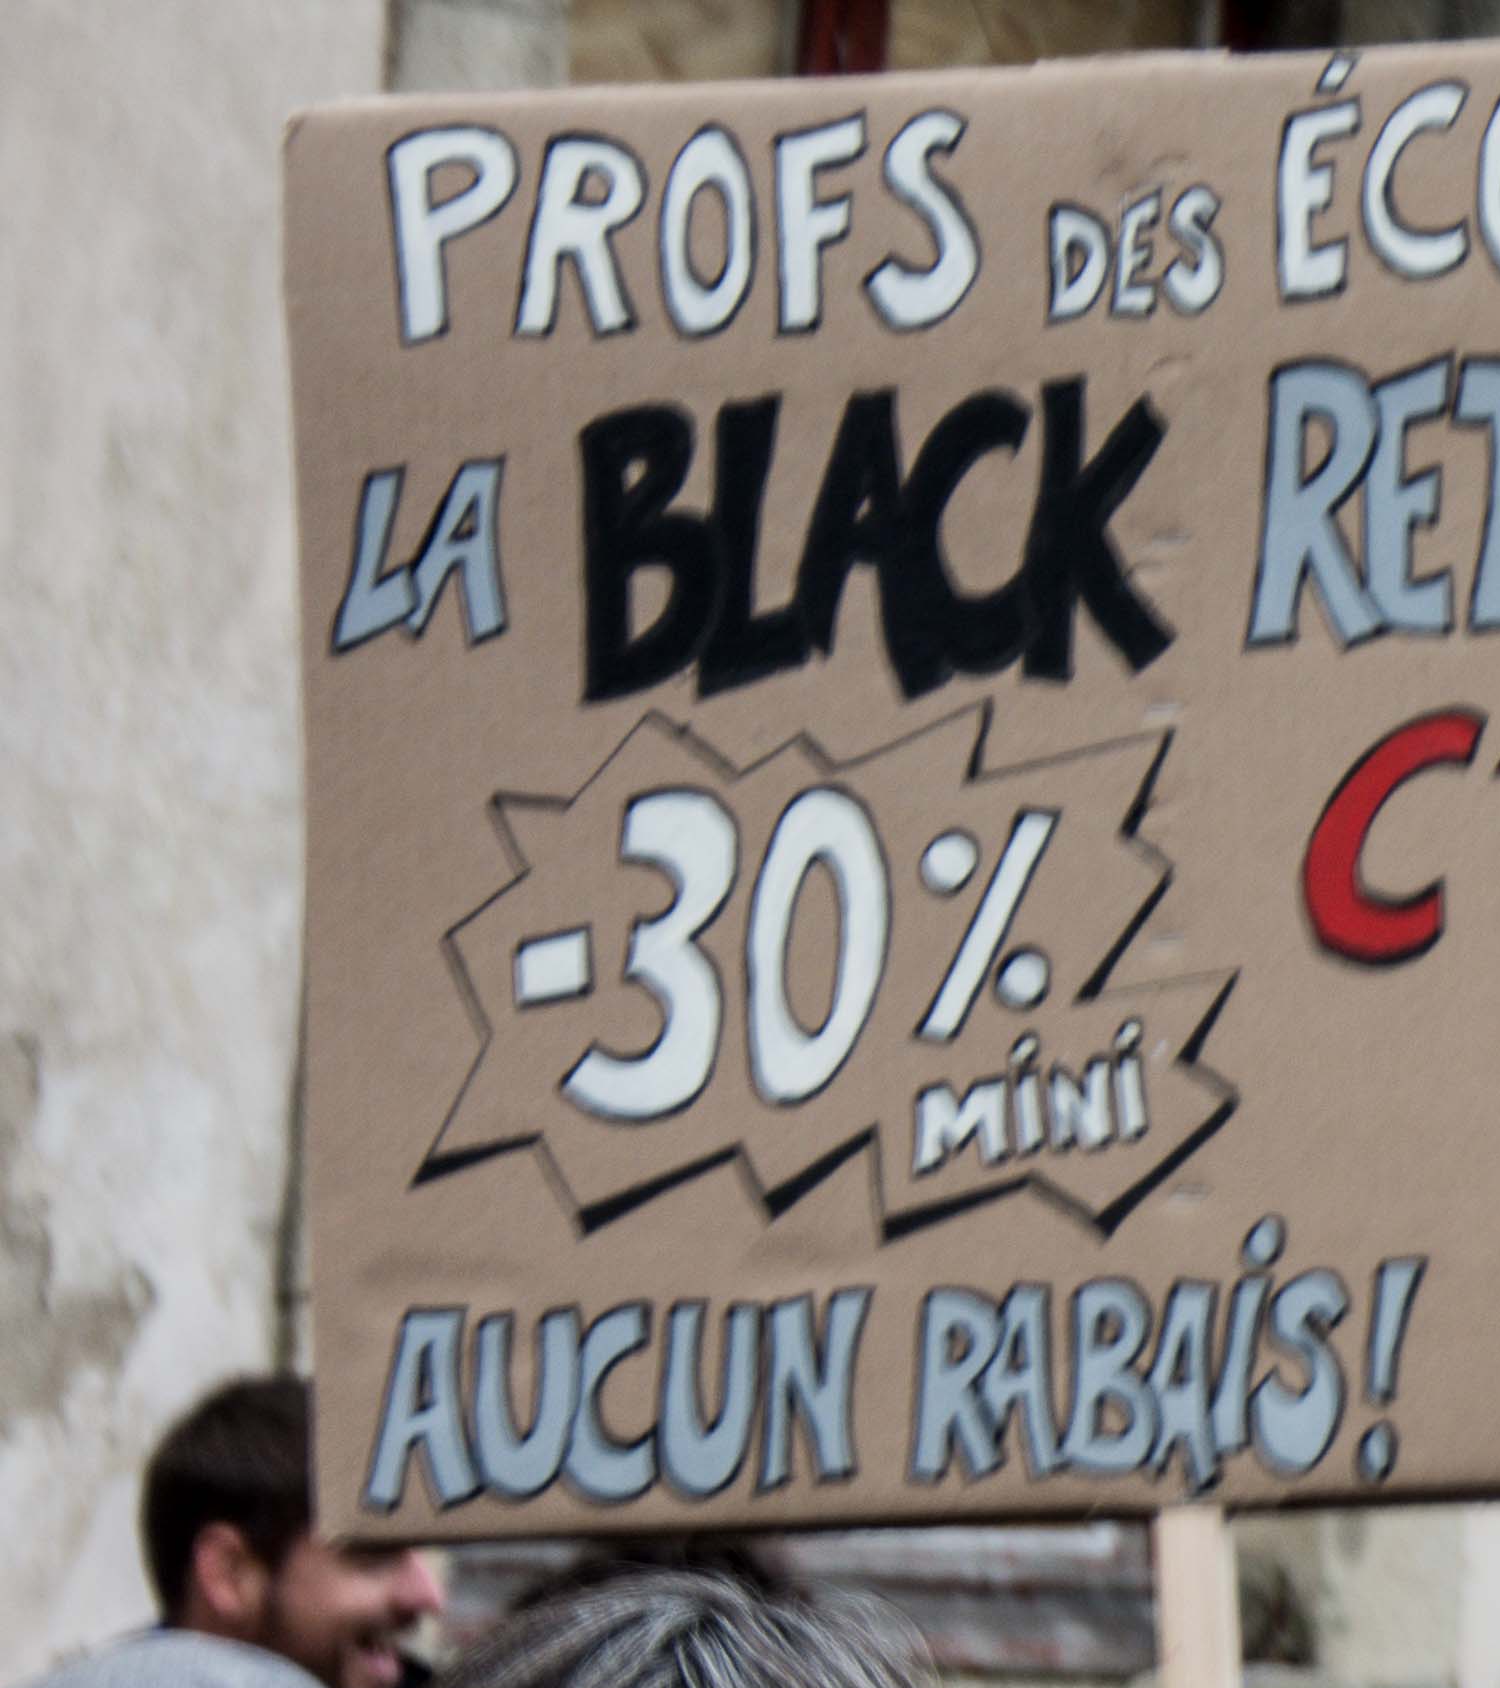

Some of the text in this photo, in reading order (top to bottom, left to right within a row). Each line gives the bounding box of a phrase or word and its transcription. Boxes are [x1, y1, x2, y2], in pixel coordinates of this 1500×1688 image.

[386, 108, 981, 347] PROFS
[1048, 185, 1224, 322] DES
[329, 455, 507, 658] LA
[578, 376, 1175, 708] BLACK
[361, 1283, 876, 1513] AUCUN
